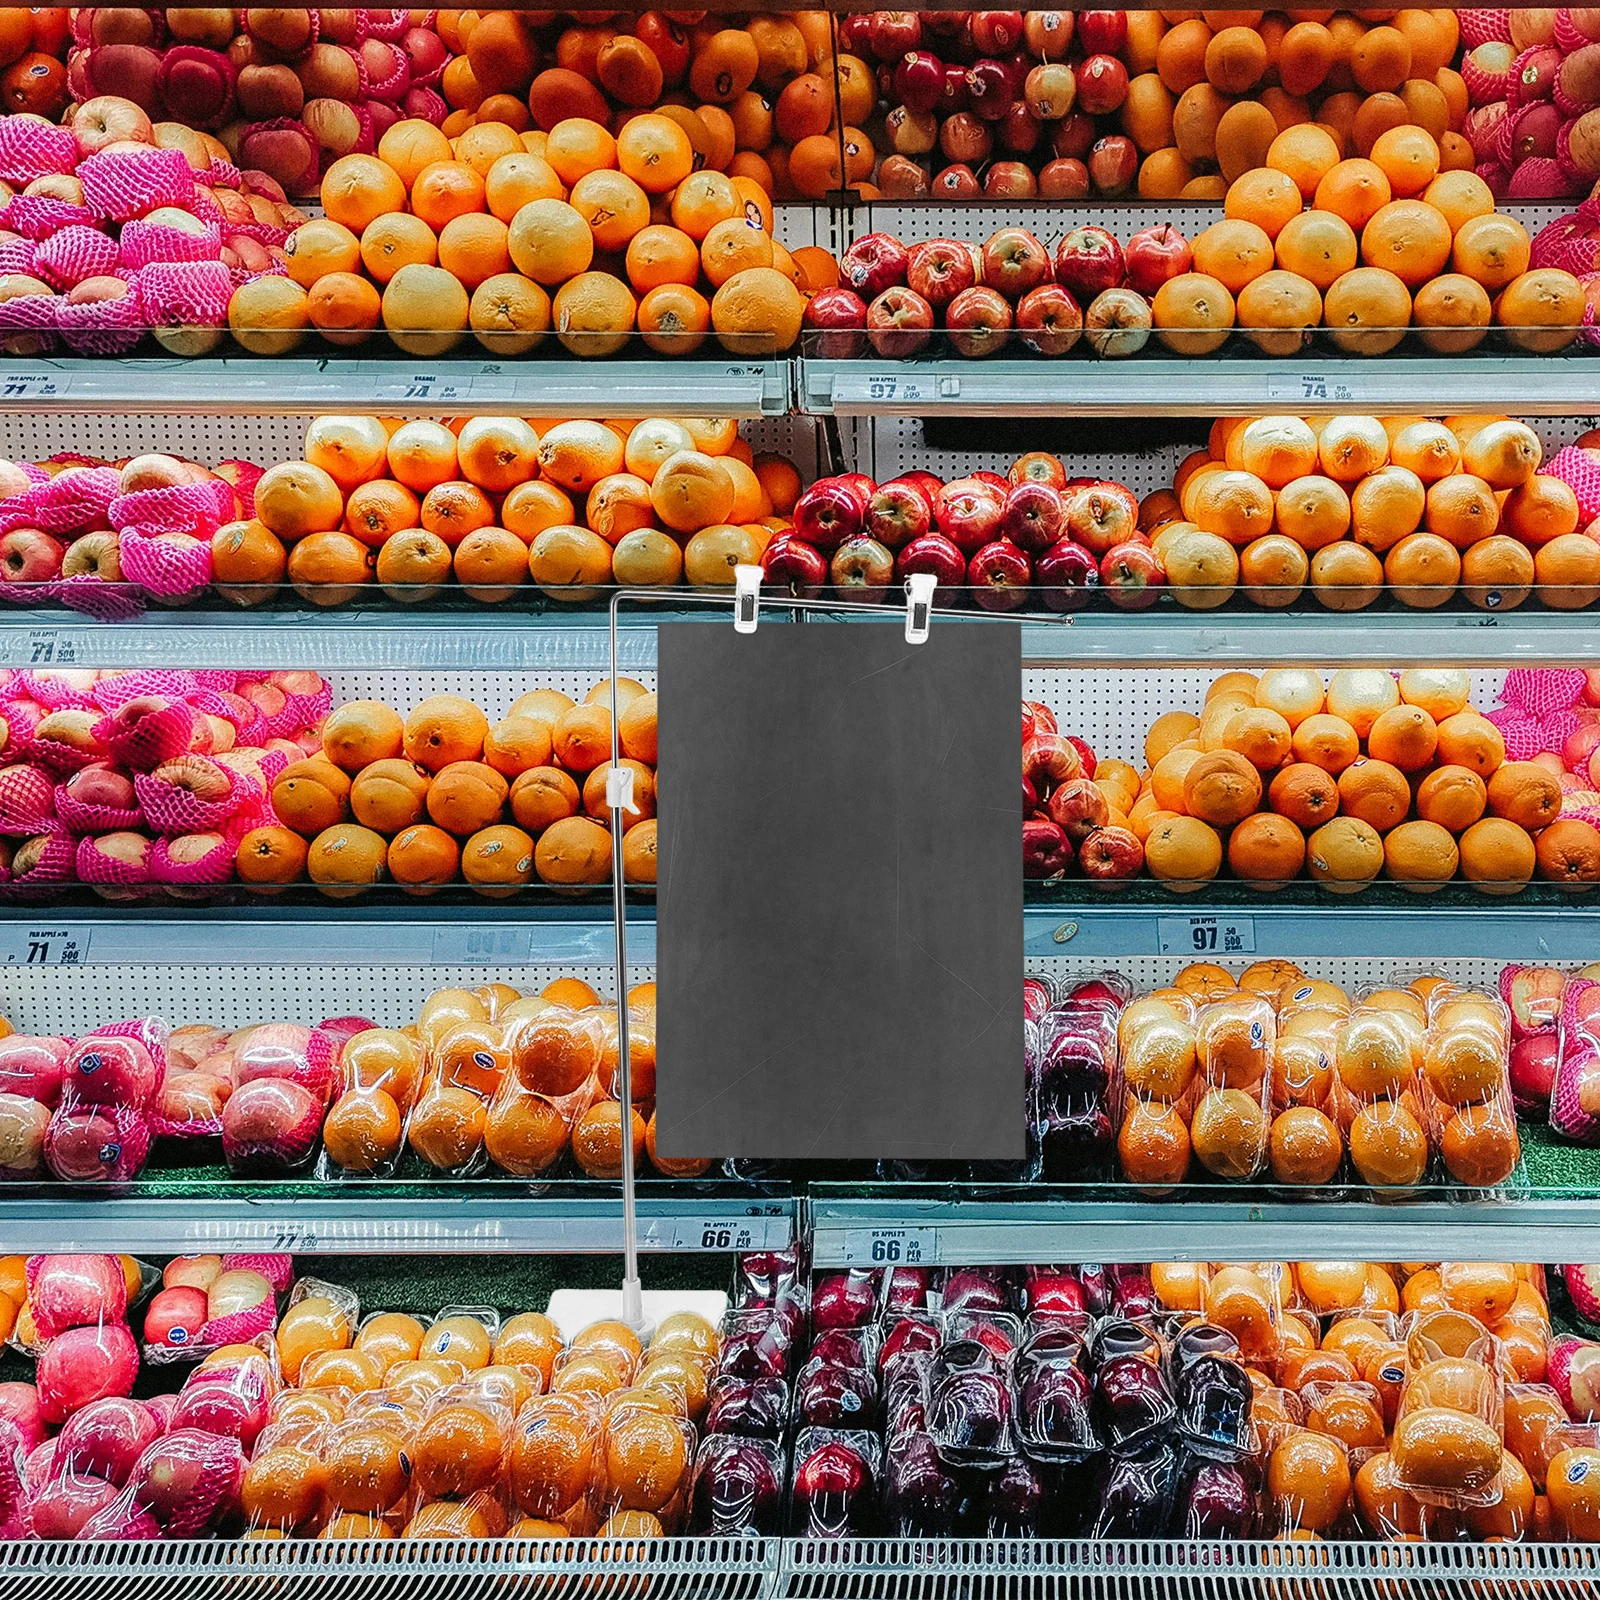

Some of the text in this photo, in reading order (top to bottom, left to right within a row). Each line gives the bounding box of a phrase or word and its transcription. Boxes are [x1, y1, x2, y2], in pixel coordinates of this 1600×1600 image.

[3, 384, 27, 395] 71
[404, 385, 430, 398] 74
[870, 384, 897, 399] 97
[1302, 383, 1328, 398] 74
[31, 642, 54, 662] 71
[58, 650, 75, 658] 500
[1193, 927, 1217, 951] 97
[1225, 936, 1241, 946] 500
[26, 942, 49, 963] 71
[61, 951, 79, 960] 500
[272, 1233, 299, 1250] 77
[701, 1230, 731, 1248] 66
[872, 1240, 901, 1261] 66
[907, 1250, 921, 1258] PER
